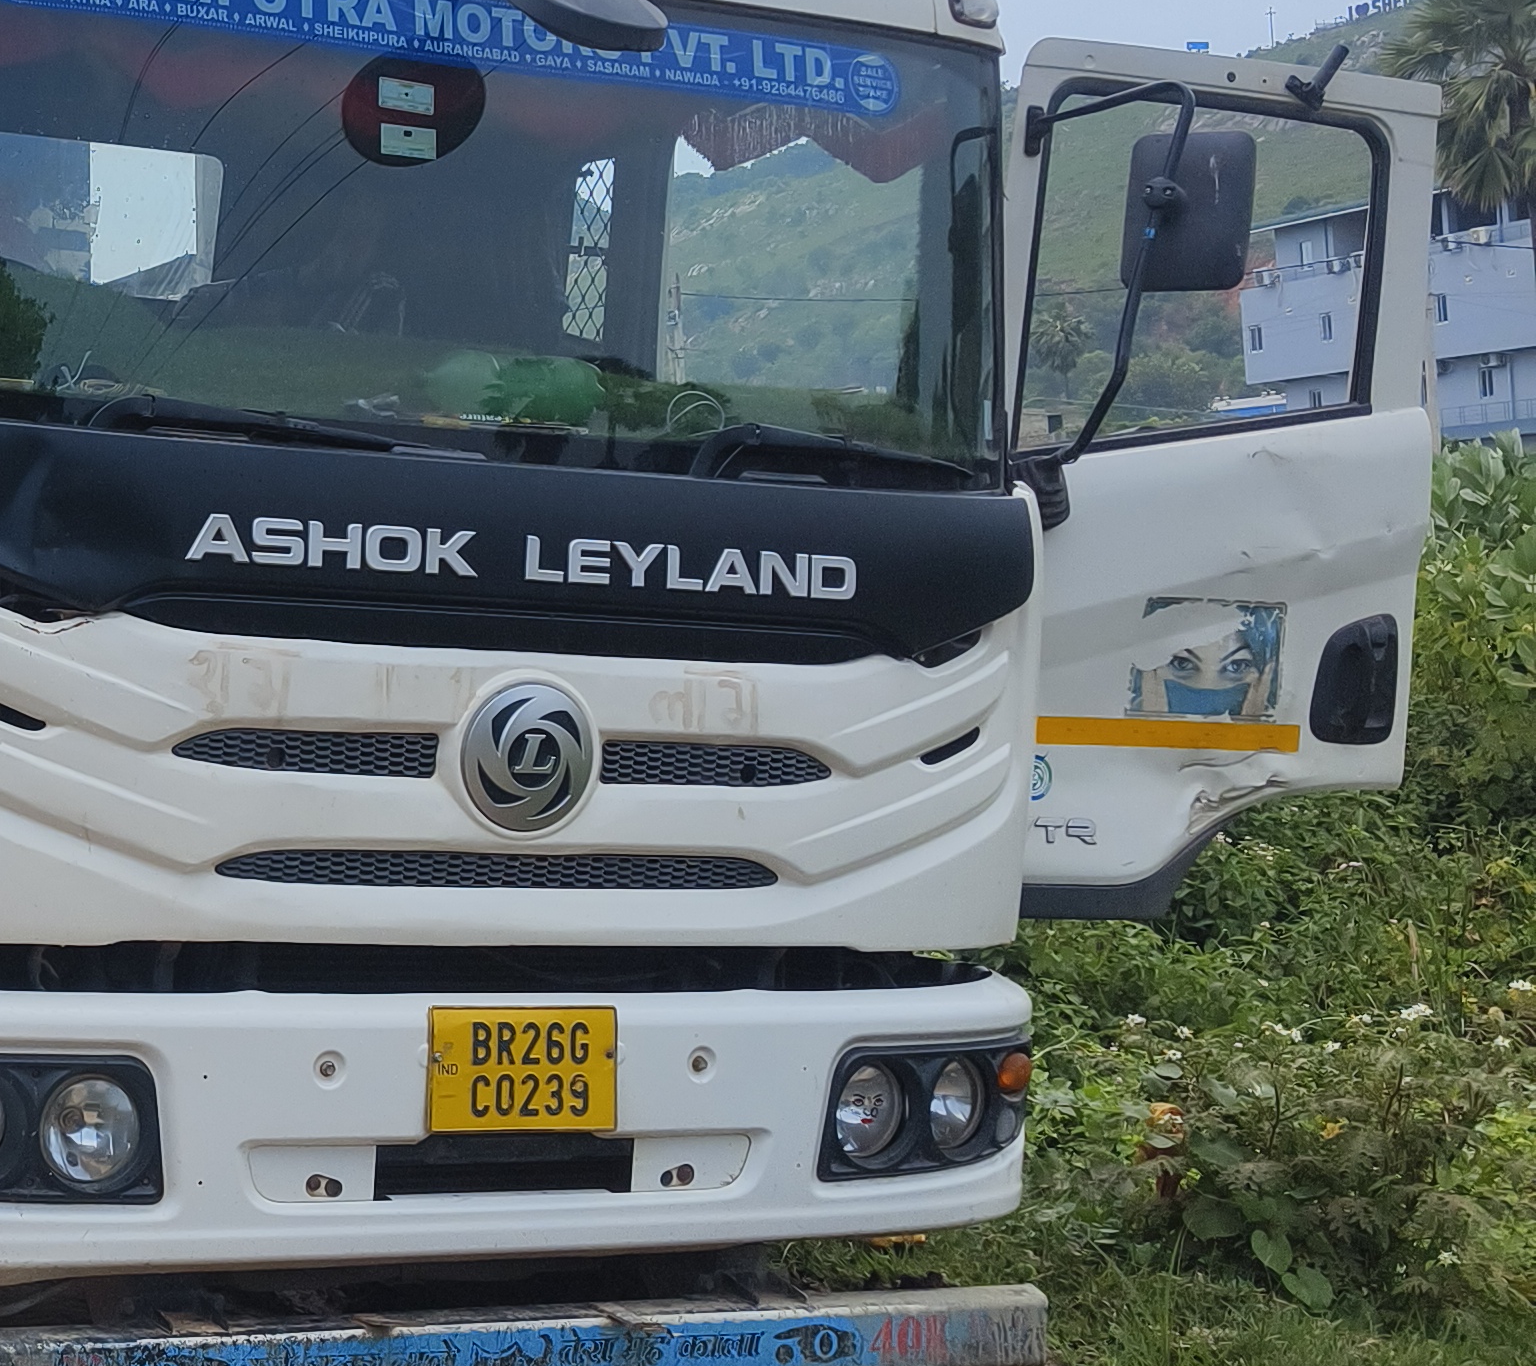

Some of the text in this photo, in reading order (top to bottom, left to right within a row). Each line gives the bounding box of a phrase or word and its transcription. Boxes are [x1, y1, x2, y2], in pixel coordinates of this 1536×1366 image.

[177, 3, 229, 22] BUXAR
[245, 13, 297, 32] ARWAL
[314, 22, 408, 49] SHEIKHPURA
[424, 39, 520, 62] AURANGABAD
[536, 54, 572, 69] GAYA
[587, 59, 651, 78] SASARAM
[665, 68, 721, 87] NAWADA
[752, 39, 845, 90] LTD.
[184, 513, 857, 600] ASHOK LEYLAND
[1033, 816, 1098, 846] TR
[471, 1021, 590, 1066] BR26G
[437, 1063, 459, 1076] IND
[470, 1073, 589, 1118] C0239
